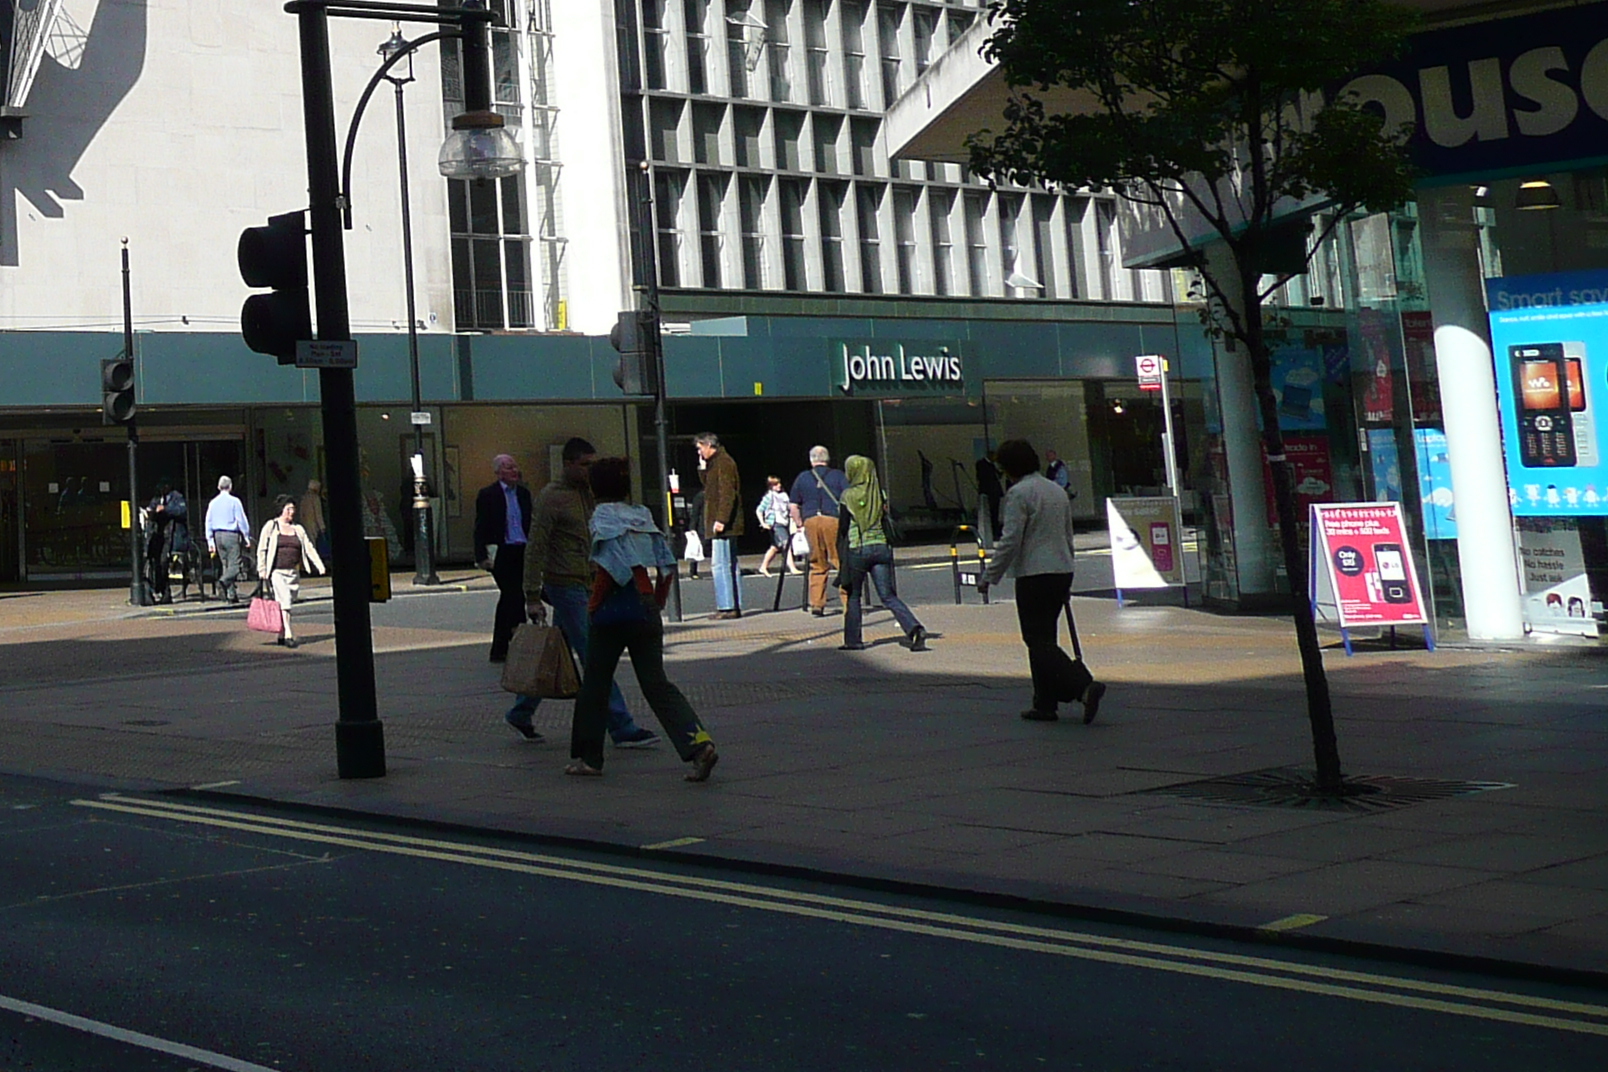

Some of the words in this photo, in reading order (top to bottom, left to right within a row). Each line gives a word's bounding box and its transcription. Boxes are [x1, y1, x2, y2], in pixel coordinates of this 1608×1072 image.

[1497, 286, 1563, 311] Smart
[841, 342, 895, 391] John
[898, 343, 961, 381] Lewis
